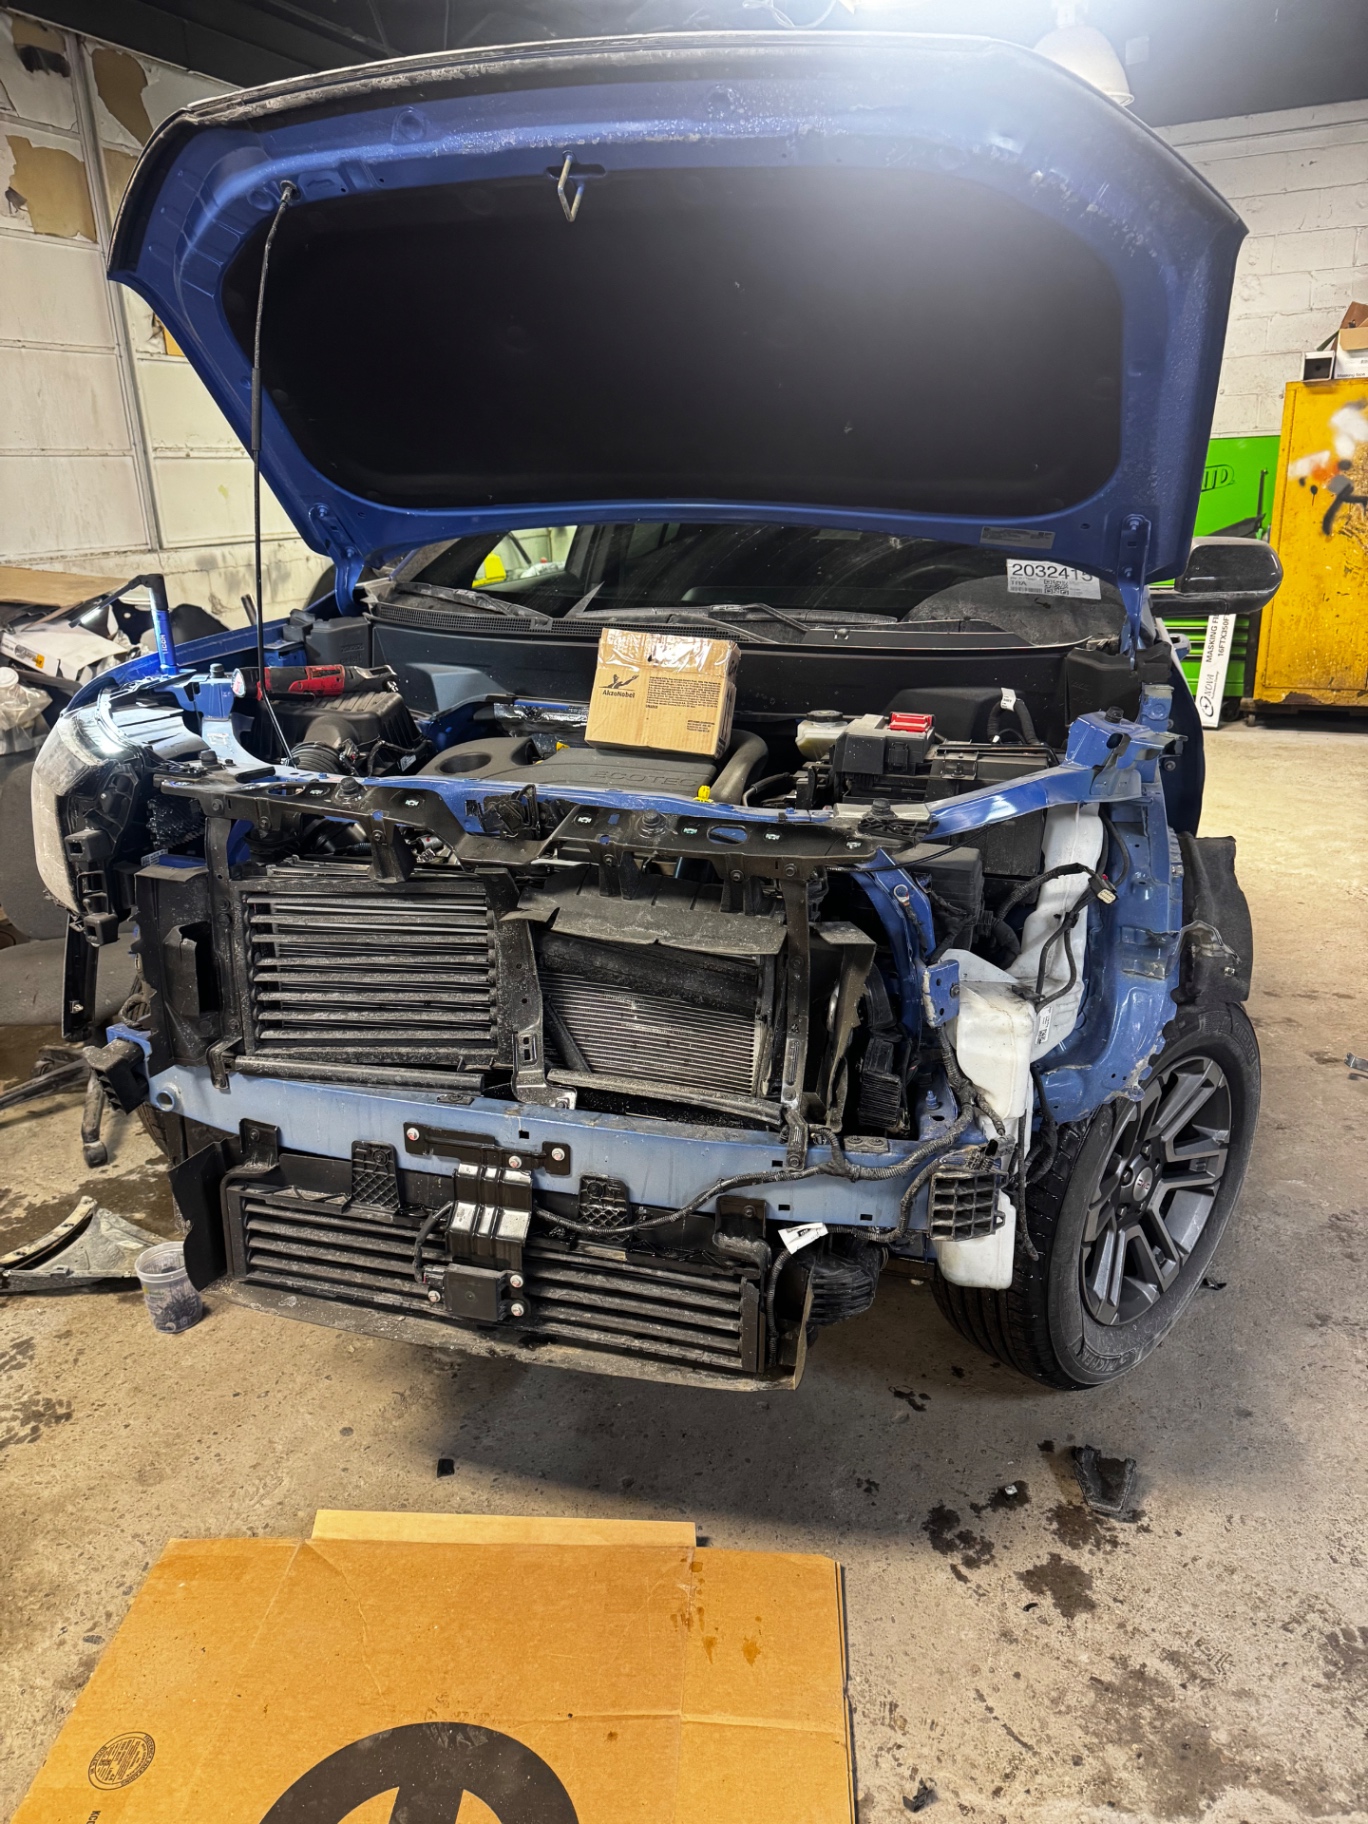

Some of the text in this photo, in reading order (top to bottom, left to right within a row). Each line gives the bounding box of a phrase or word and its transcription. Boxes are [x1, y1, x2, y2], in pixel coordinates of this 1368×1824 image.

[1012, 563, 1093, 582] 2032415
[1206, 625, 1218, 663] MASKING
[602, 689, 636, 698] AkzoNobel
[590, 770, 699, 787] ECOTEC
